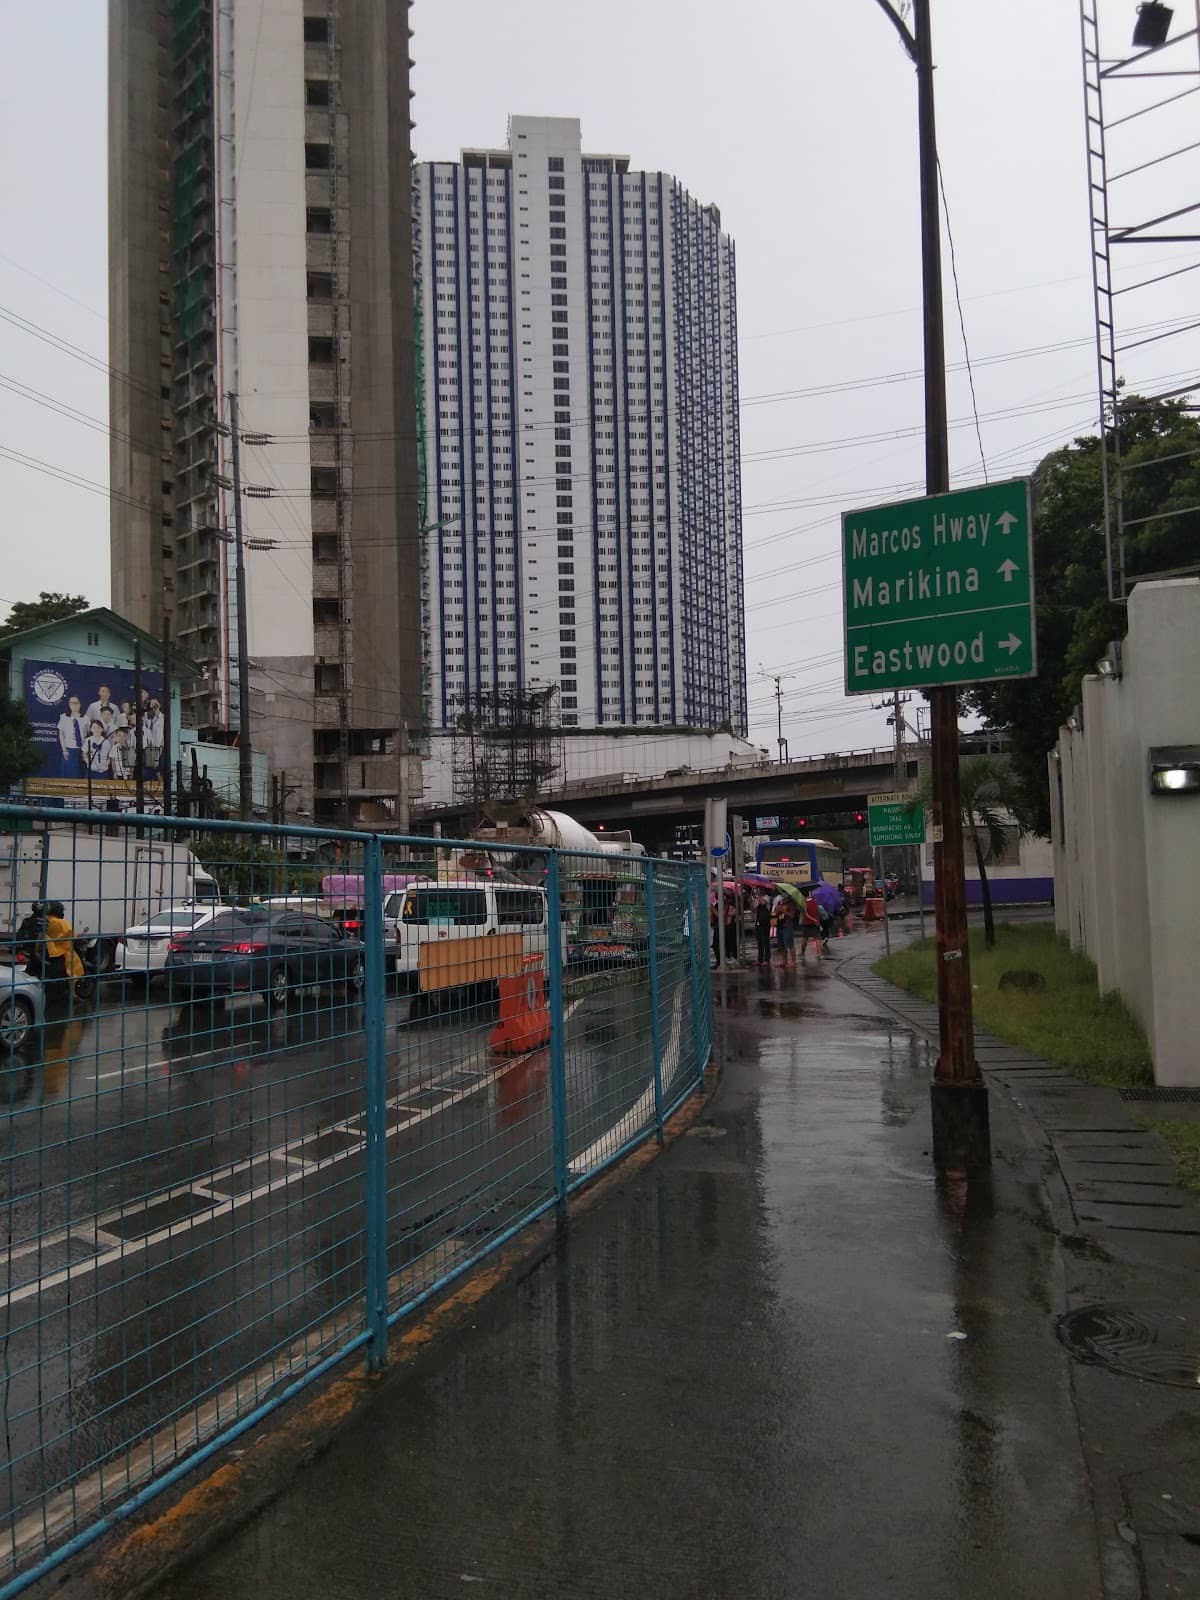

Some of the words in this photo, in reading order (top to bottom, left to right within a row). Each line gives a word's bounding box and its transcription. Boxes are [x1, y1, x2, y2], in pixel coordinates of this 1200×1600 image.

[852, 525, 921, 560] Marcos
[933, 512, 991, 546] Hway
[853, 566, 979, 608] Marikina
[854, 631, 984, 676] Eastwood
